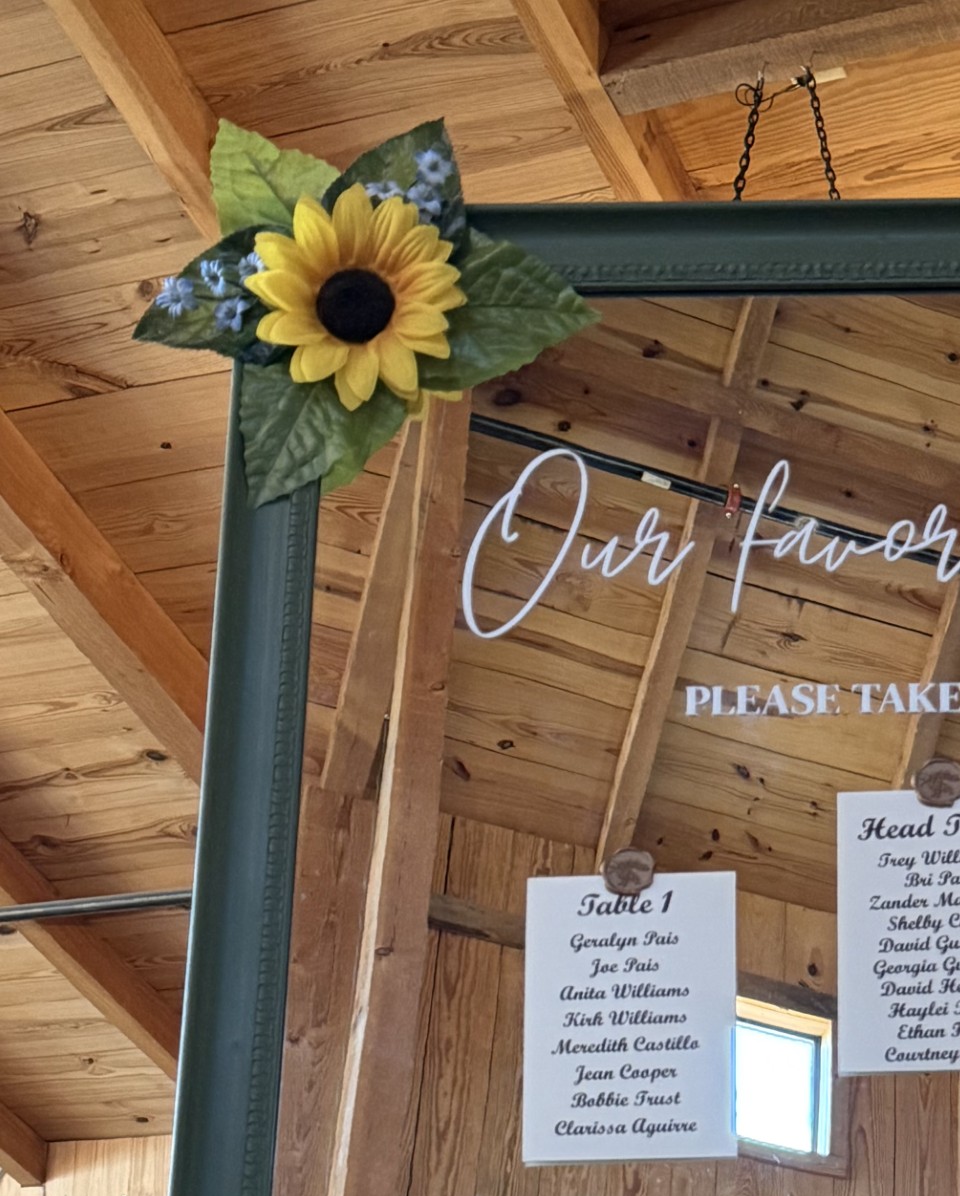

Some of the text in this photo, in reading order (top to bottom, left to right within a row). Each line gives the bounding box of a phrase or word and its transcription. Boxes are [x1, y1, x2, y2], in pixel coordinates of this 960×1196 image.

[461, 448, 695, 638] Our
[684, 683, 841, 717] PLEASE
[857, 814, 935, 840] Head
[878, 853, 916, 870] Trey
[904, 873, 933, 887] Bri
[577, 890, 673, 916] Table 1
[870, 894, 929, 910] Zander
[643, 931, 679, 946] Pais
[878, 936, 931, 953] David
[590, 958, 659, 978] Joe Pais
[873, 960, 937, 979] Georgia
[560, 983, 689, 1001] Anita Williams
[881, 979, 933, 997] David
[563, 1010, 687, 1027] Kirk Williams
[897, 1024, 945, 1040] Ethan
[884, 1047, 959, 1064] Courtney
[574, 1064, 677, 1085] Jean Cooper
